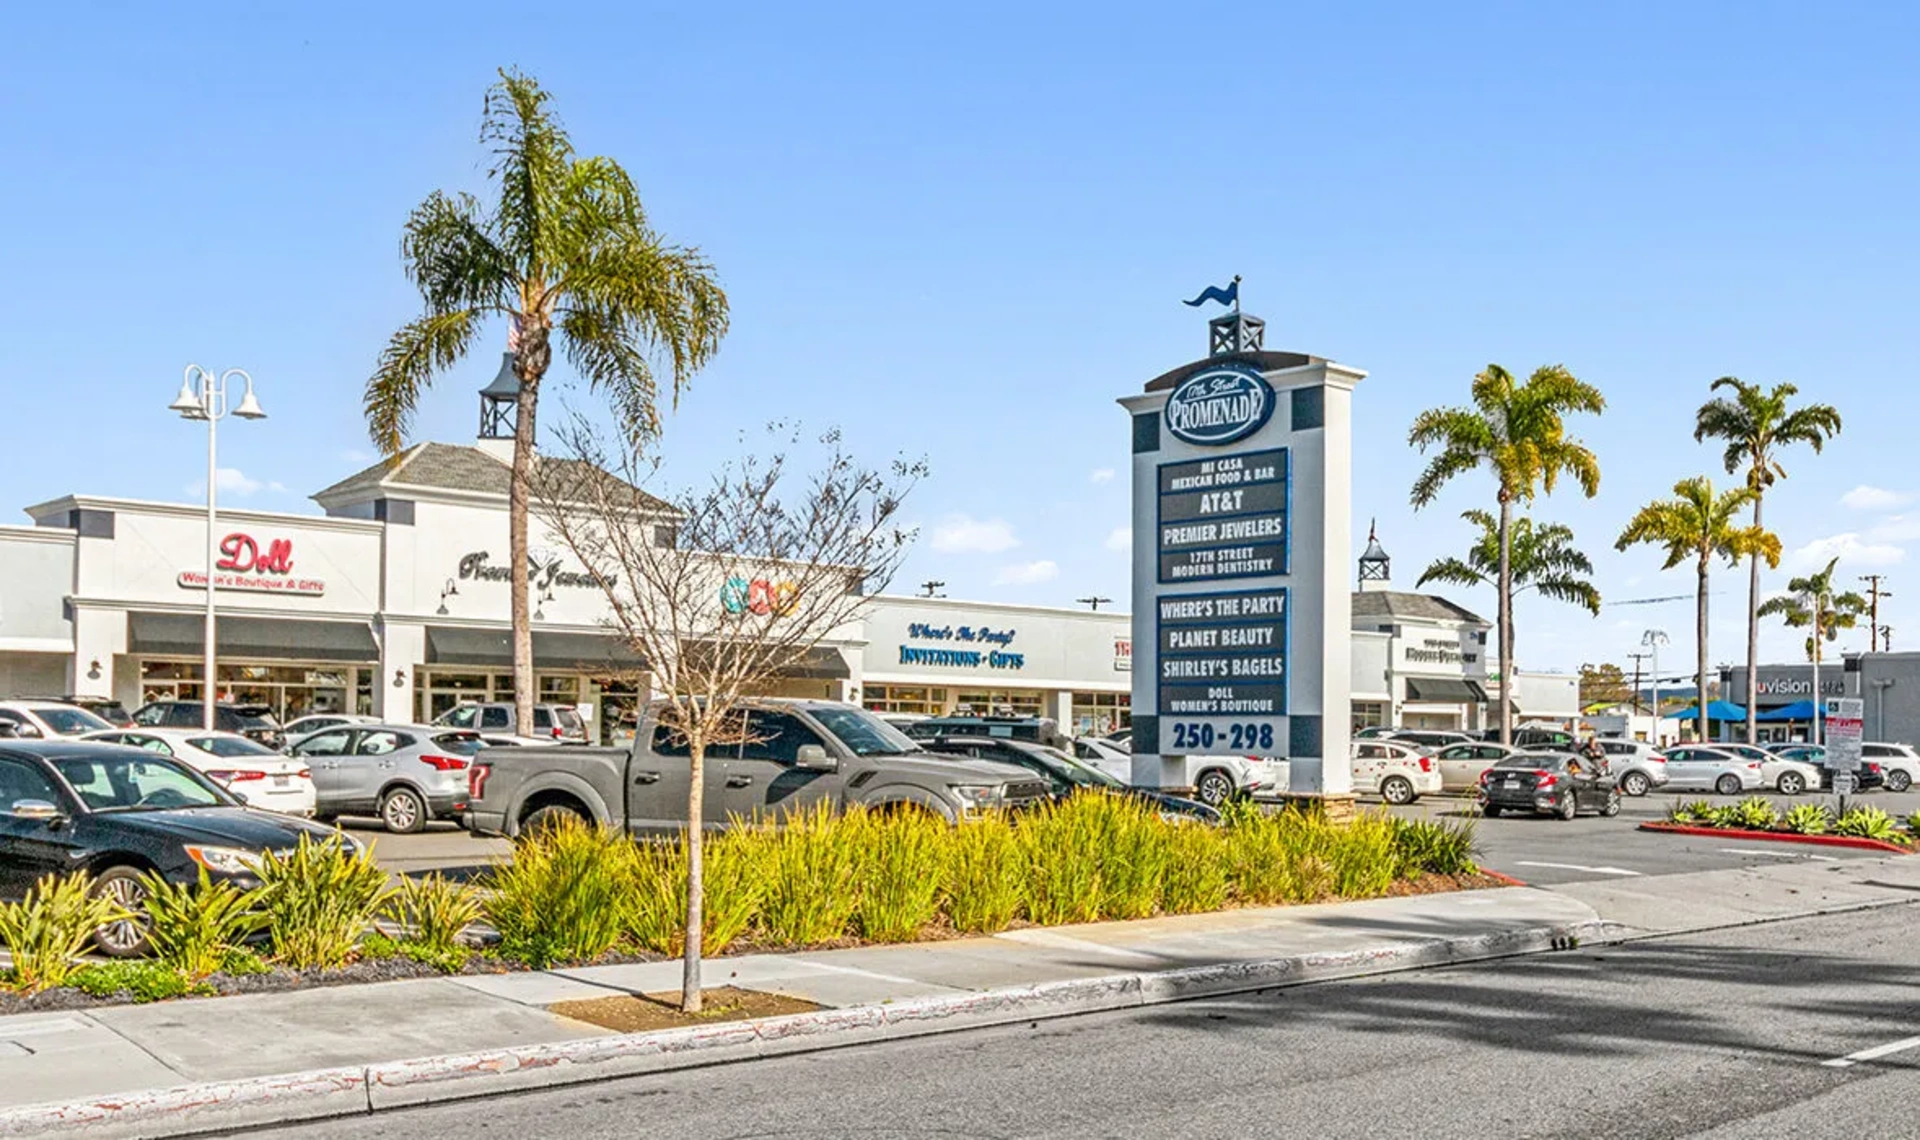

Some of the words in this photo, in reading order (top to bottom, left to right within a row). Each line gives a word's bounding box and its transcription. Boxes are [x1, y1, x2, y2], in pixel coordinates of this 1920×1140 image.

[1209, 375, 1243, 396] Street
[1171, 388, 1264, 430] PROMENADE
[1201, 461, 1214, 473] MI
[1218, 458, 1243, 471] CASA
[1171, 475, 1213, 490] MEXICAN
[1215, 472, 1240, 485] FOOD
[1243, 470, 1251, 481] &
[1254, 467, 1275, 480] BAR
[1200, 490, 1243, 513] AT&T
[1163, 524, 1217, 545] PREMIER
[1219, 518, 1282, 540] JEWELERS
[216, 532, 294, 574] Doll
[1190, 551, 1214, 564] 17TH
[1218, 547, 1254, 561] STREET
[1172, 563, 1214, 577] MODERN
[1217, 558, 1273, 574] DENTISTRY
[235, 576, 282, 590] Boutique
[286, 579, 296, 589] &
[298, 580, 325, 591] Gifts
[1161, 600, 1213, 619] WHERE'S
[1216, 599, 1239, 616] THE
[1242, 596, 1285, 615] PARTY
[1169, 630, 1217, 648] PLANET
[1221, 627, 1273, 646] BEAUTY
[1163, 660, 1228, 678] SHIRLEY'S
[1232, 658, 1283, 676] BAGELS
[1208, 687, 1233, 699] DOLL
[1170, 700, 1218, 712] WOMEN'S
[1220, 700, 1273, 712] BOUTIQUE
